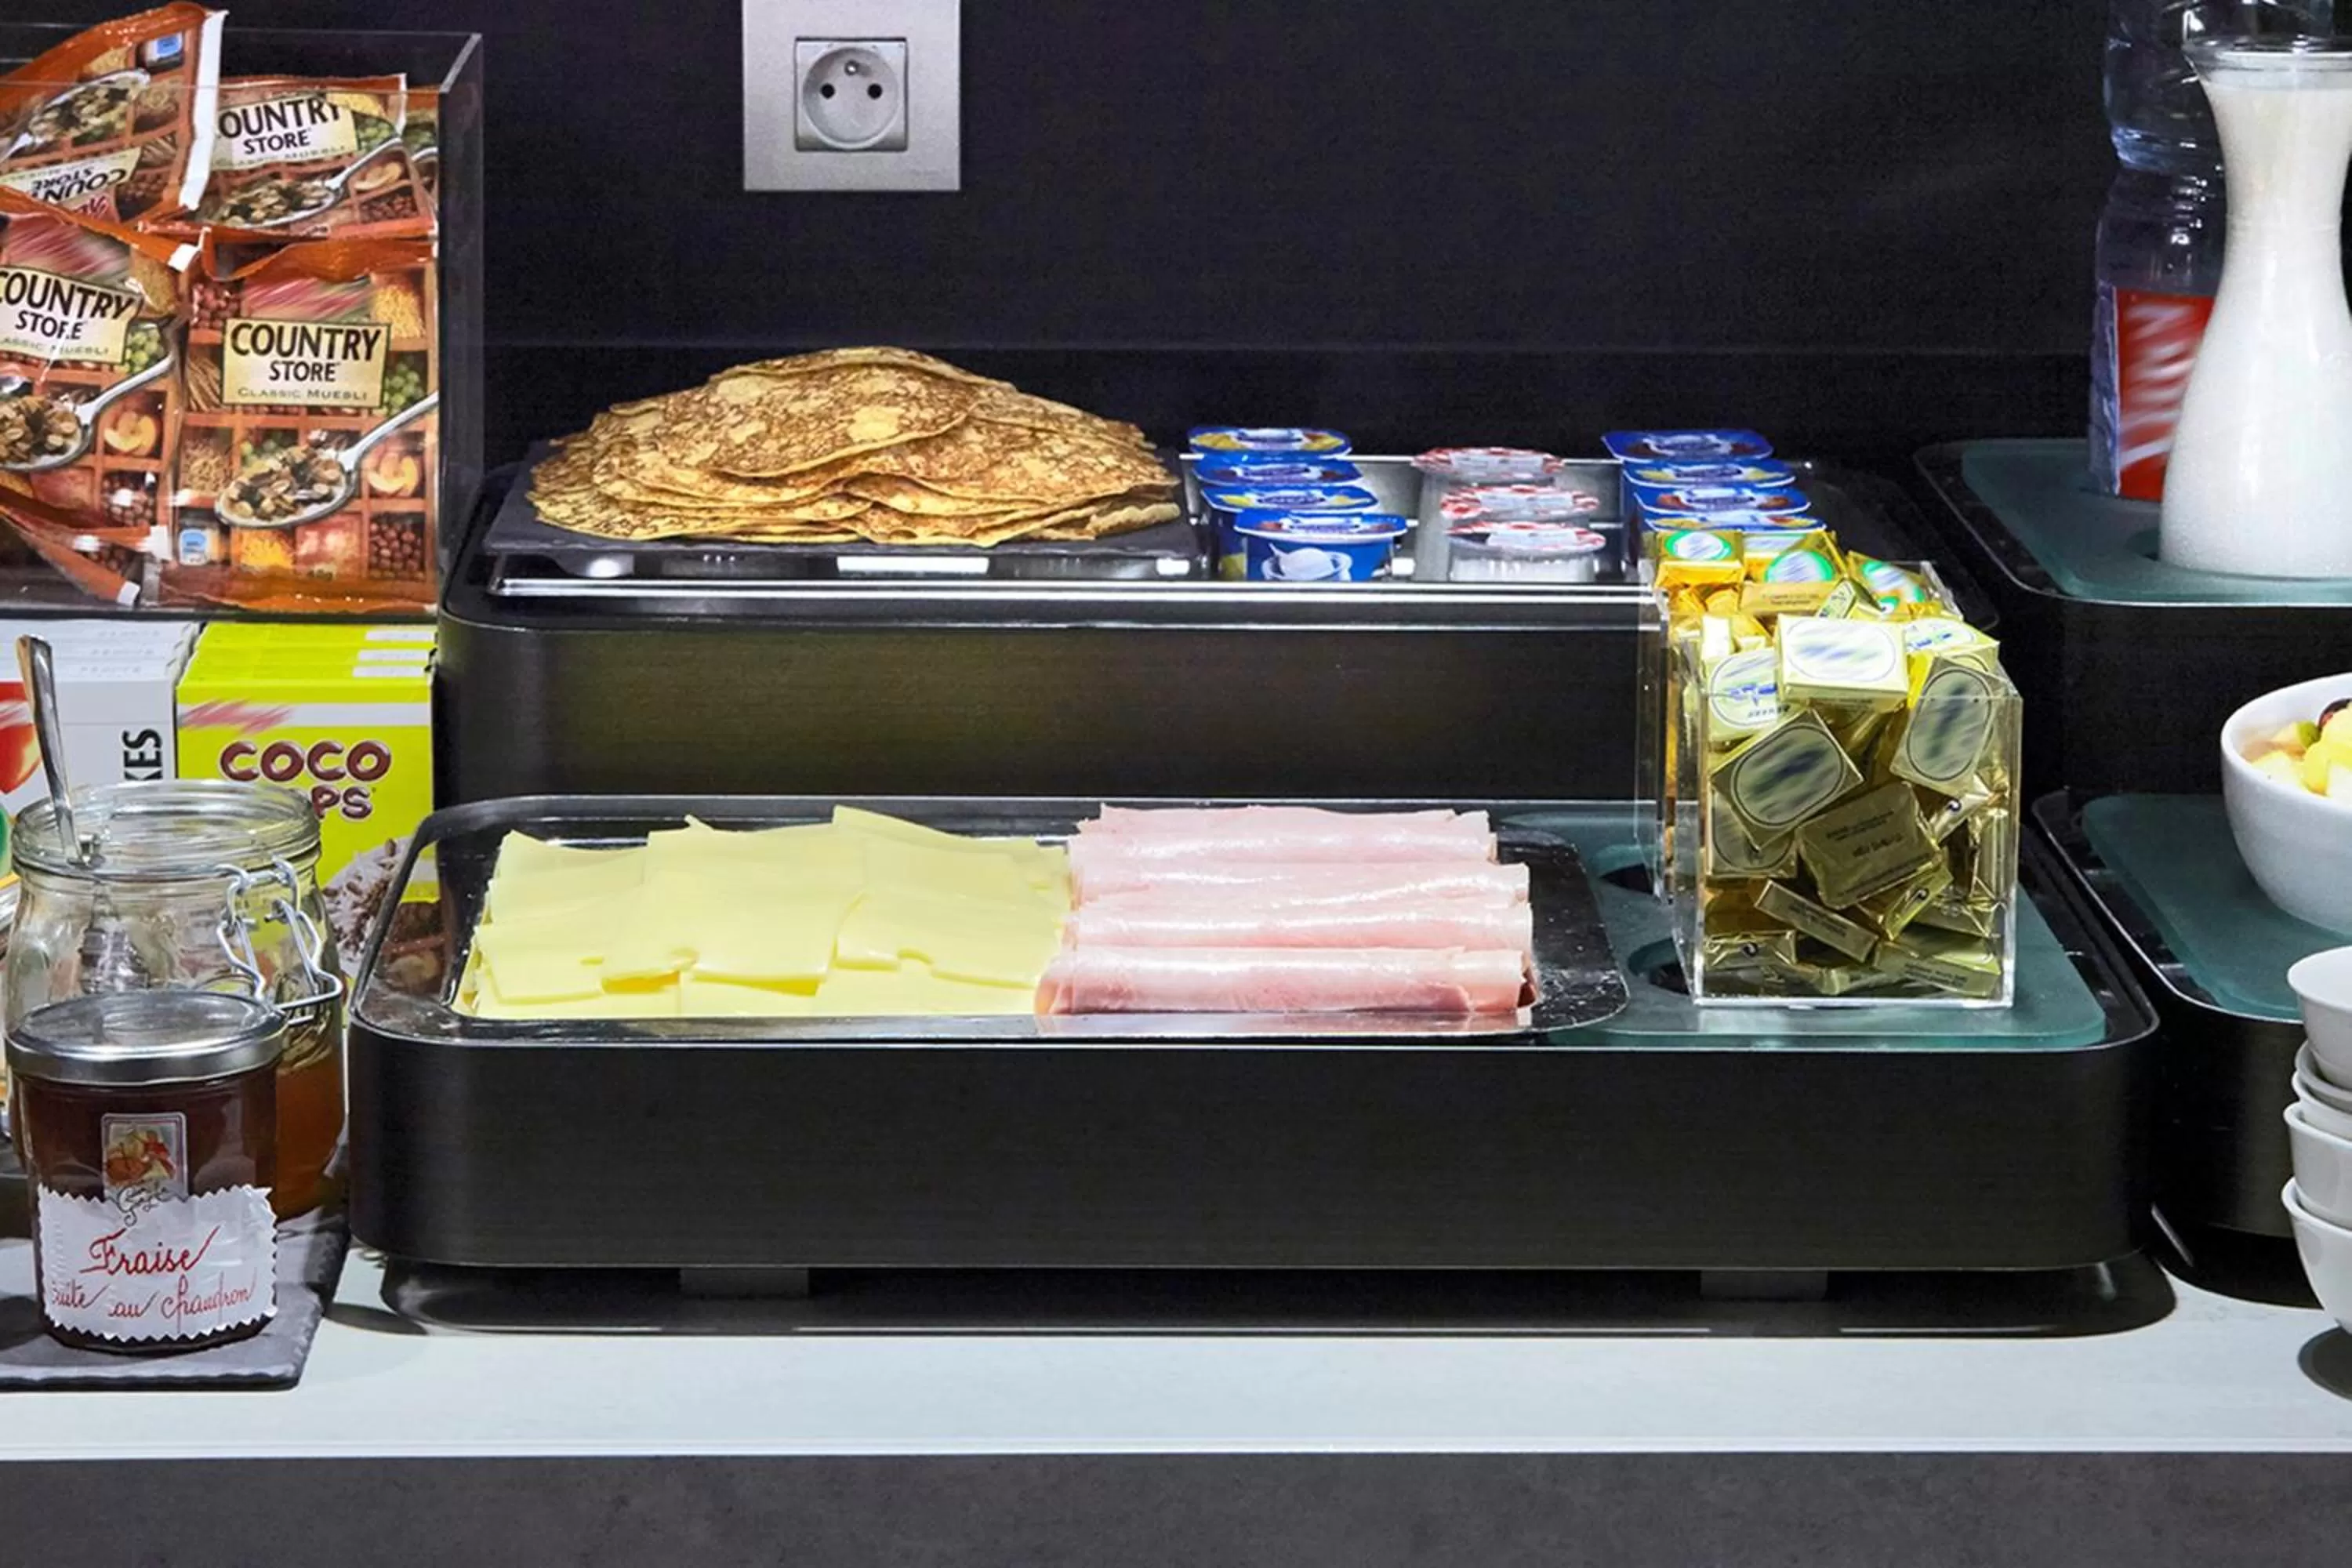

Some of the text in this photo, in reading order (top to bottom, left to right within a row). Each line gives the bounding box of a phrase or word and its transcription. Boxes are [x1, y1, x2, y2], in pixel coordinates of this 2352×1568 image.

[219, 98, 340, 139] OUNTRY
[244, 129, 310, 155] STORE
[31, 169, 127, 201] COUN
[230, 322, 381, 361] COUNTRY
[269, 360, 336, 383] STORE
[220, 740, 392, 782] COCO
[310, 785, 373, 820] PS
[79, 1225, 222, 1276] Fraise
